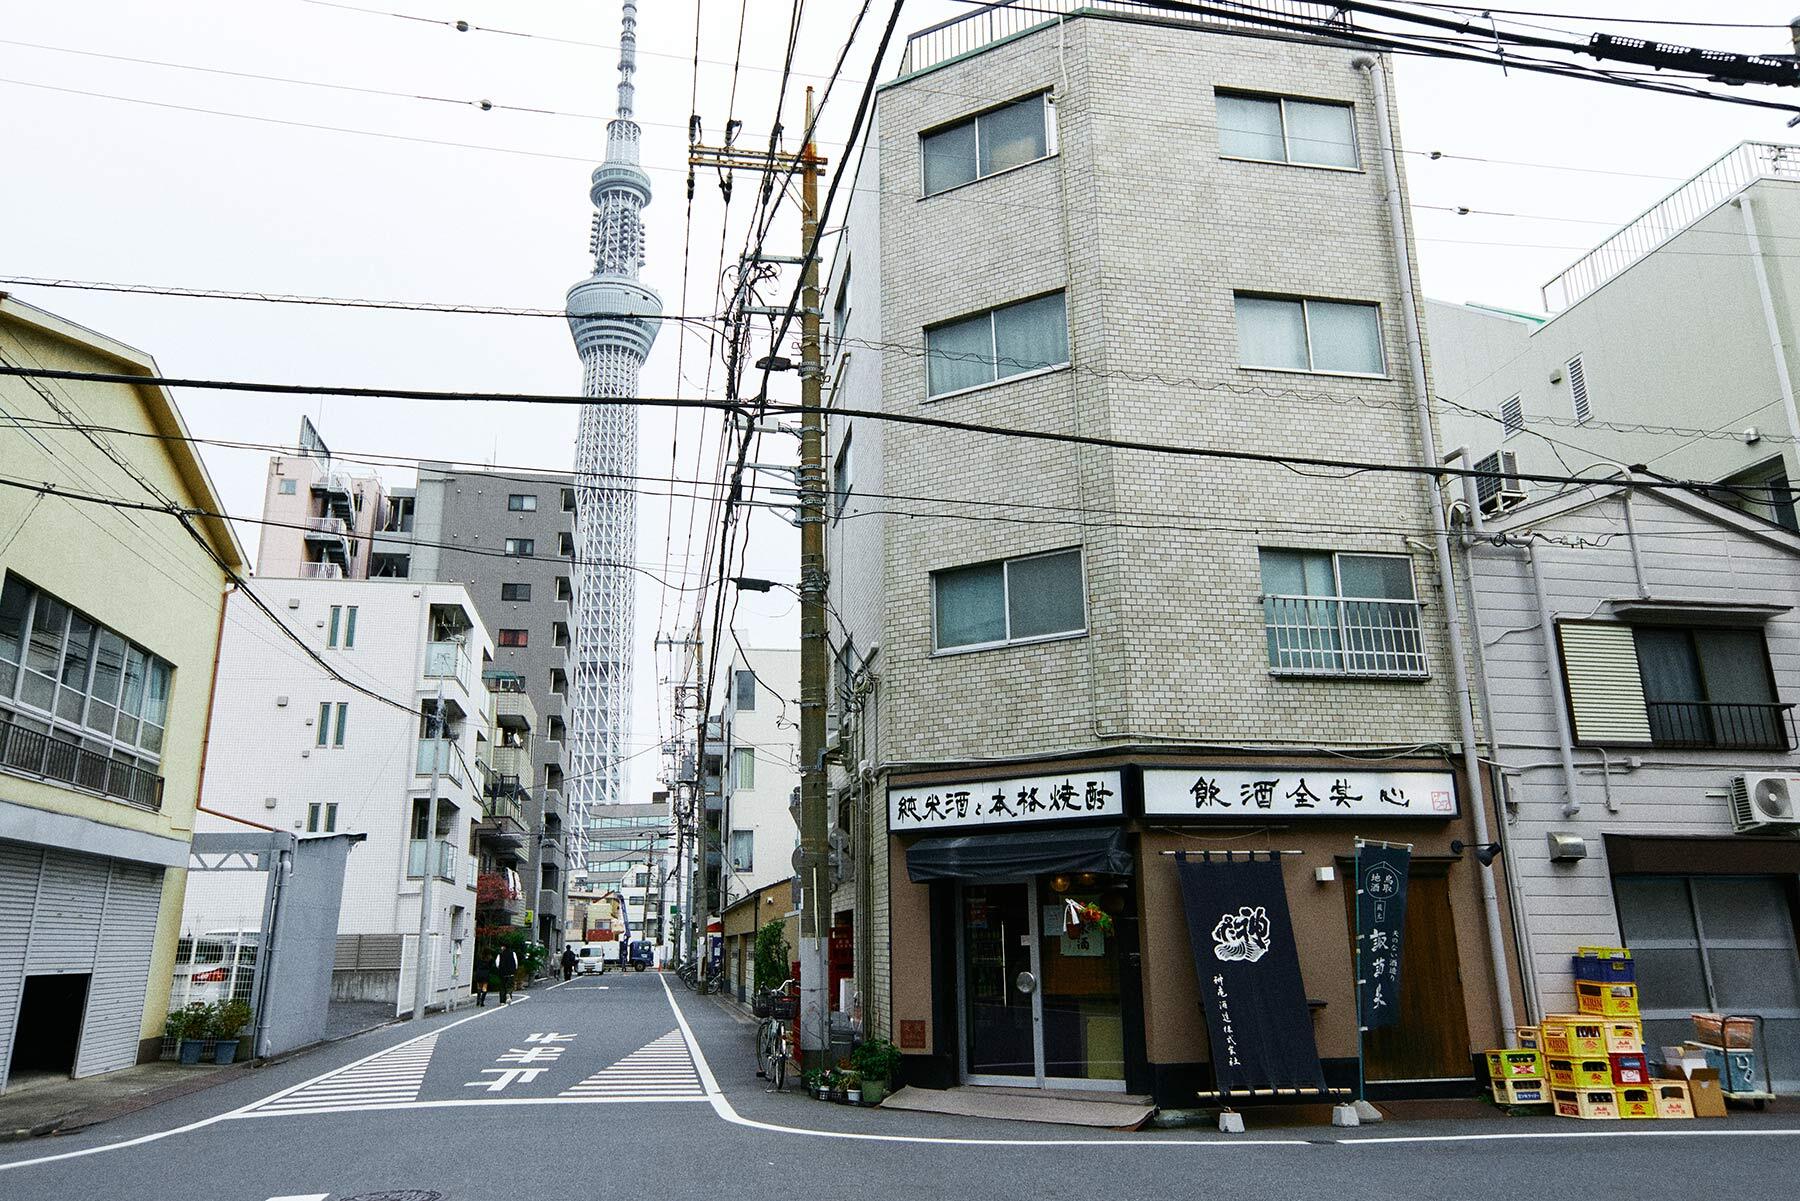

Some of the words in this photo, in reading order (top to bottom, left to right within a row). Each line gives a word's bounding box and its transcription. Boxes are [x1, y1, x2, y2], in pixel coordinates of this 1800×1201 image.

[897, 778, 1115, 824] 純米酒と本格焼酎
[1370, 872, 1381, 893] 地酒
[463, 1032, 578, 1091] 止まれ
